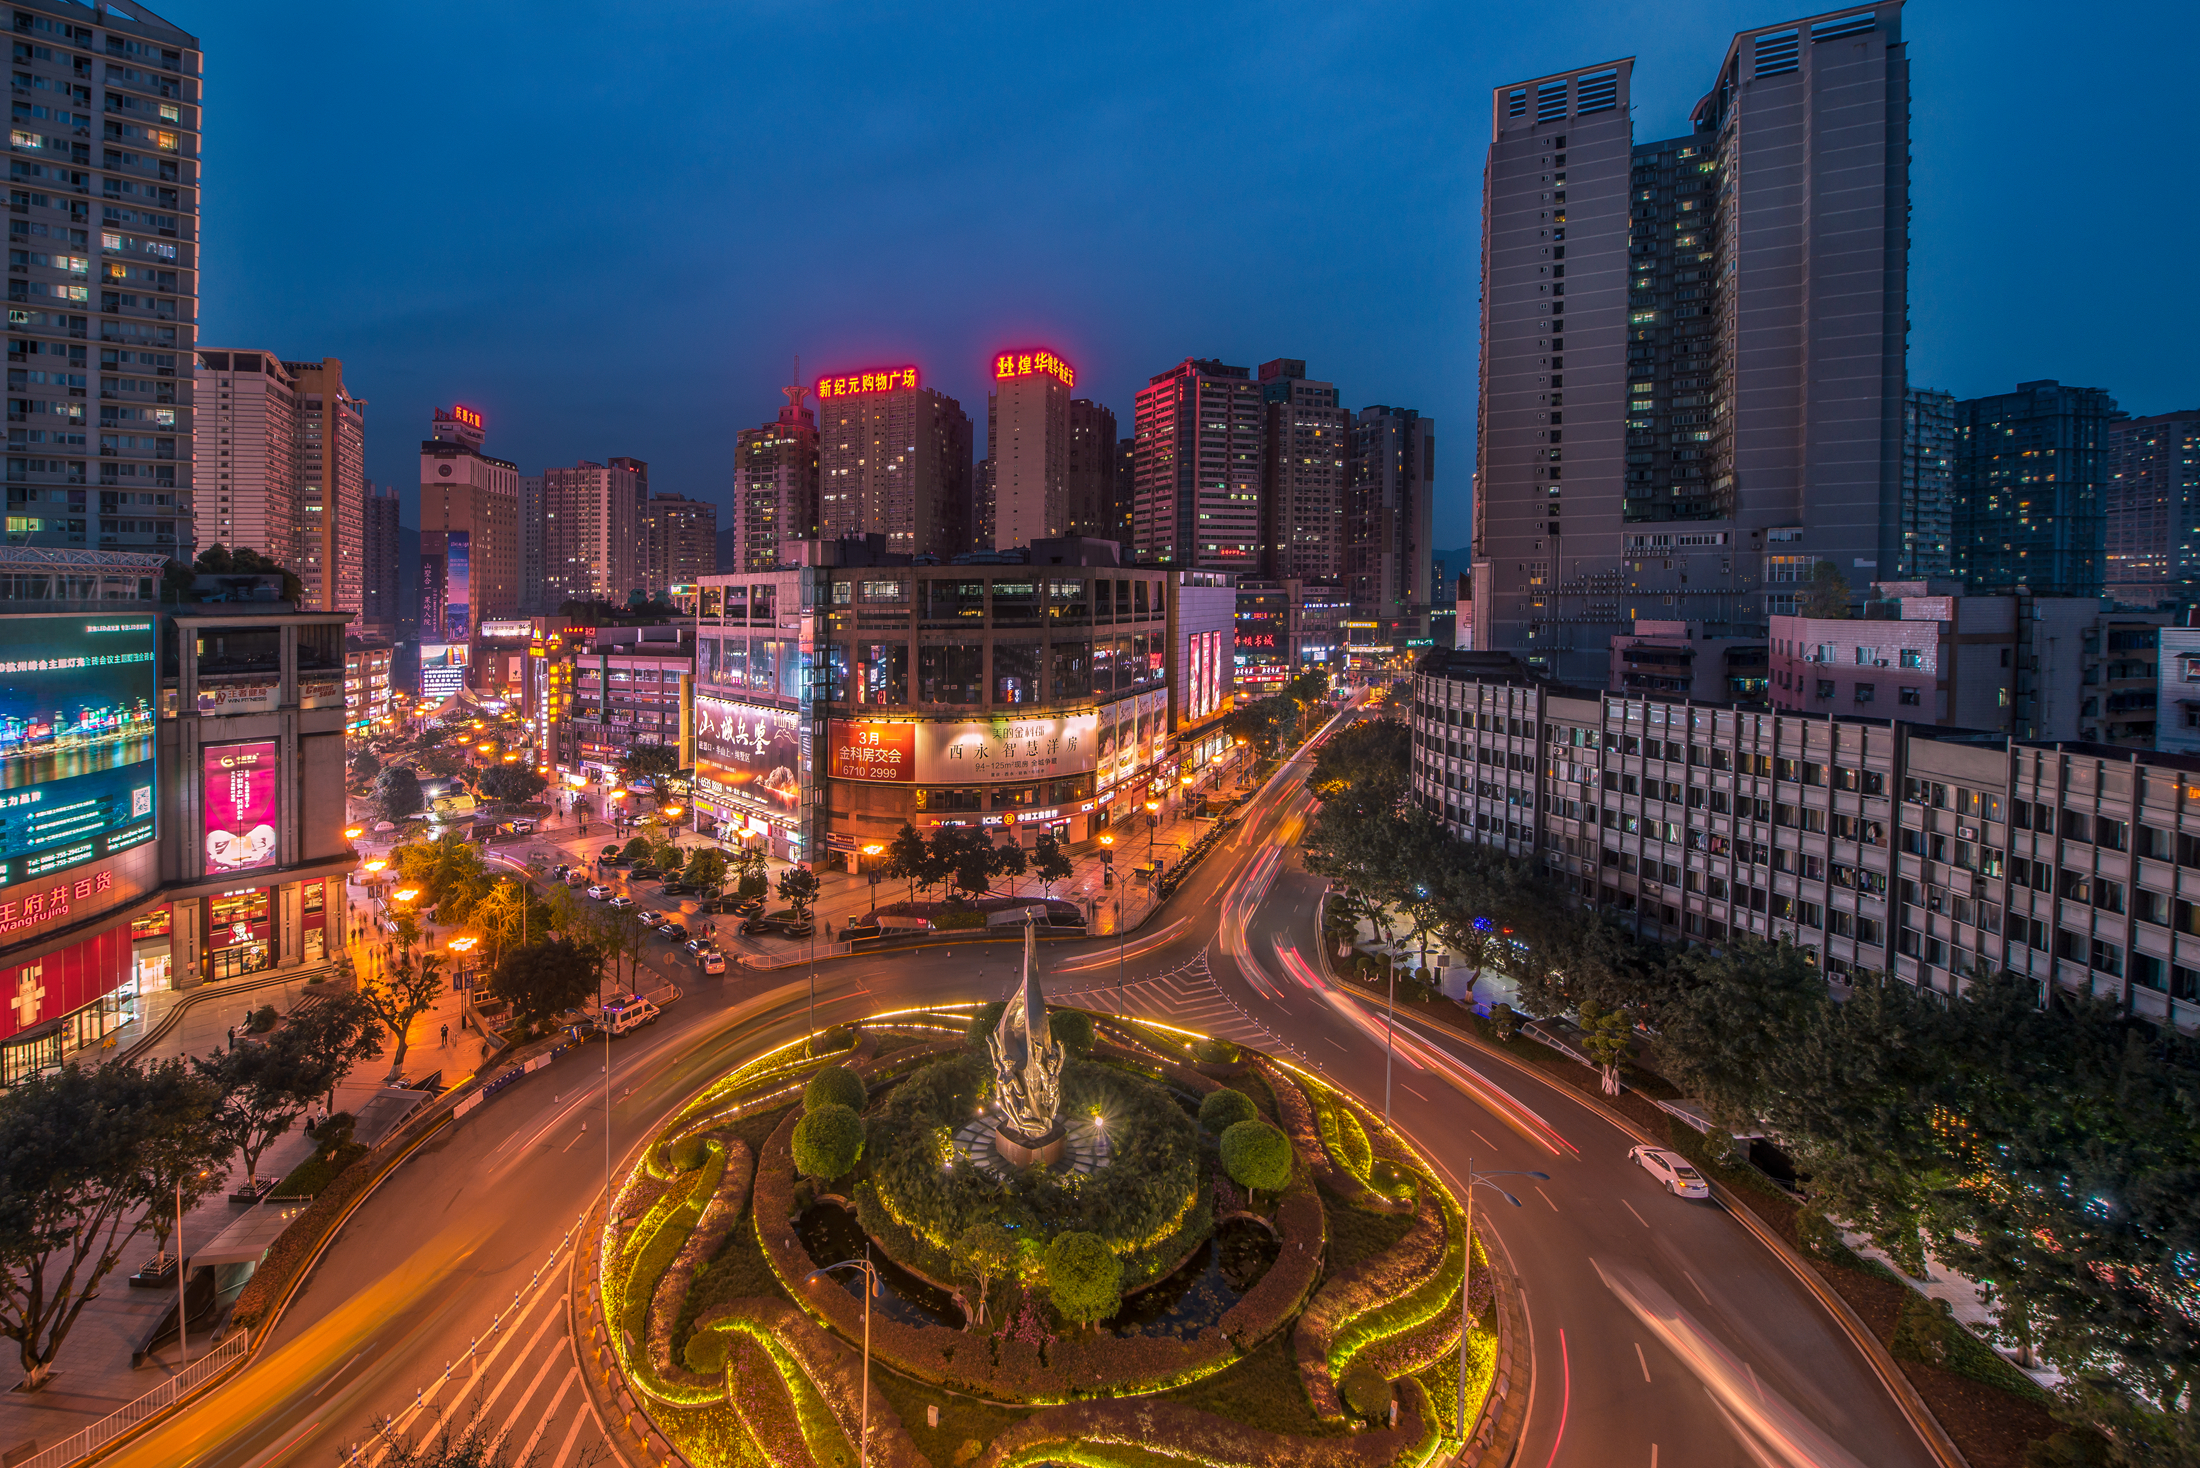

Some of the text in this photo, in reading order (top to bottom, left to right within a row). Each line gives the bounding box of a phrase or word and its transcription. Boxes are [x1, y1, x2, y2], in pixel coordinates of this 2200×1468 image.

[1018, 352, 1048, 375] 煌华
[819, 369, 915, 398] 新纪元购物广场
[228, 688, 267, 699] 王者健身
[858, 732, 879, 745] 3月
[949, 736, 1078, 760] 西永智慧洋房
[839, 745, 902, 763] 金科房交会
[843, 765, 897, 779] 6710 2999
[982, 816, 1003, 825] ICBC
[1017, 809, 1058, 822] 中国工商银行
[0, 871, 112, 923] 王府井百货
[0, 905, 69, 934] Wangfujing
